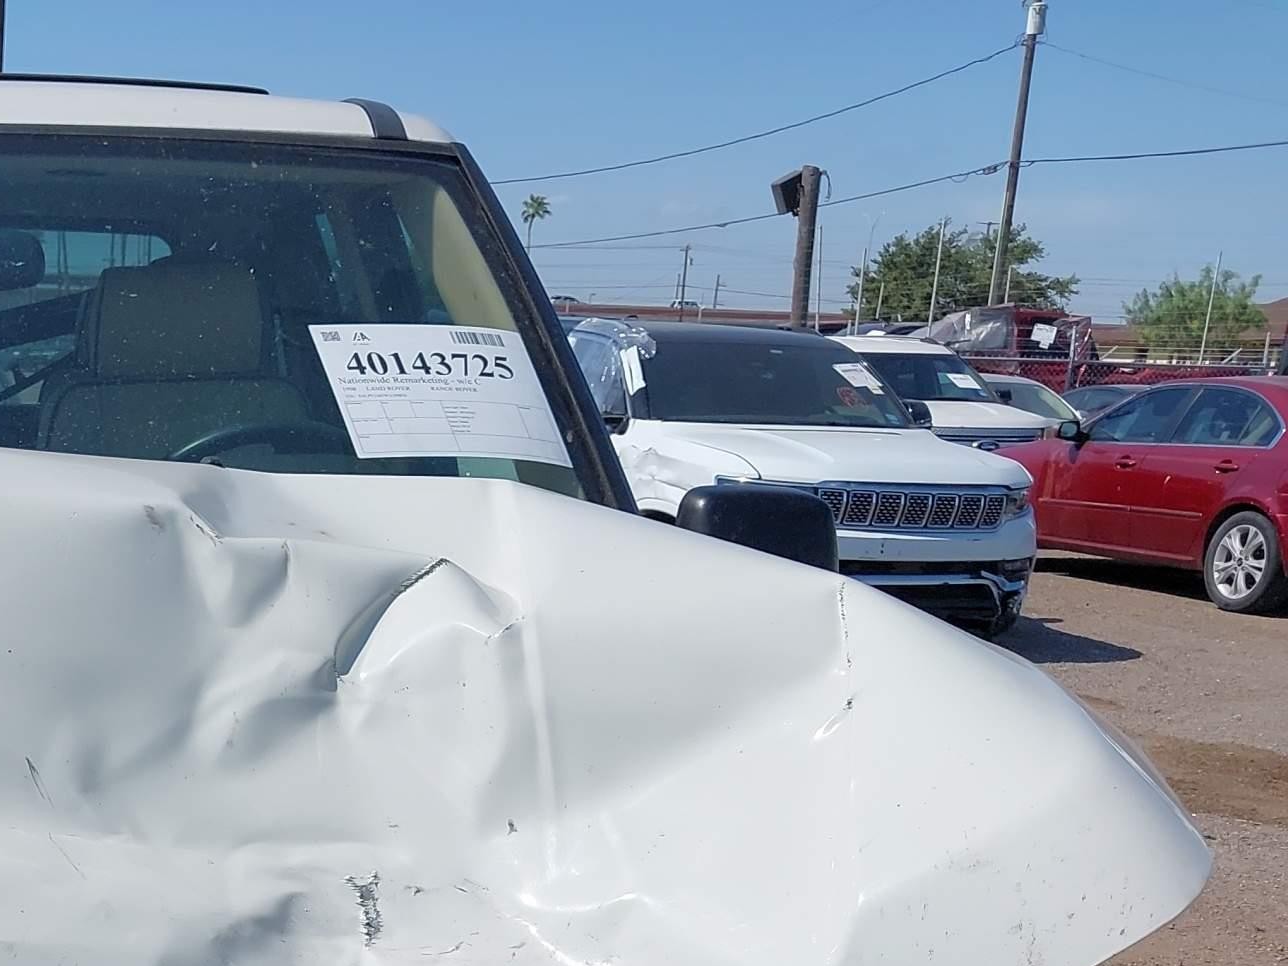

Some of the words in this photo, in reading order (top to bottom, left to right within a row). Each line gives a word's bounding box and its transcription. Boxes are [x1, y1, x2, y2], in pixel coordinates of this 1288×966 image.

[347, 351, 514, 380] 40143725
[337, 377, 391, 385] Nationwide
[392, 376, 449, 386] Remarketing
